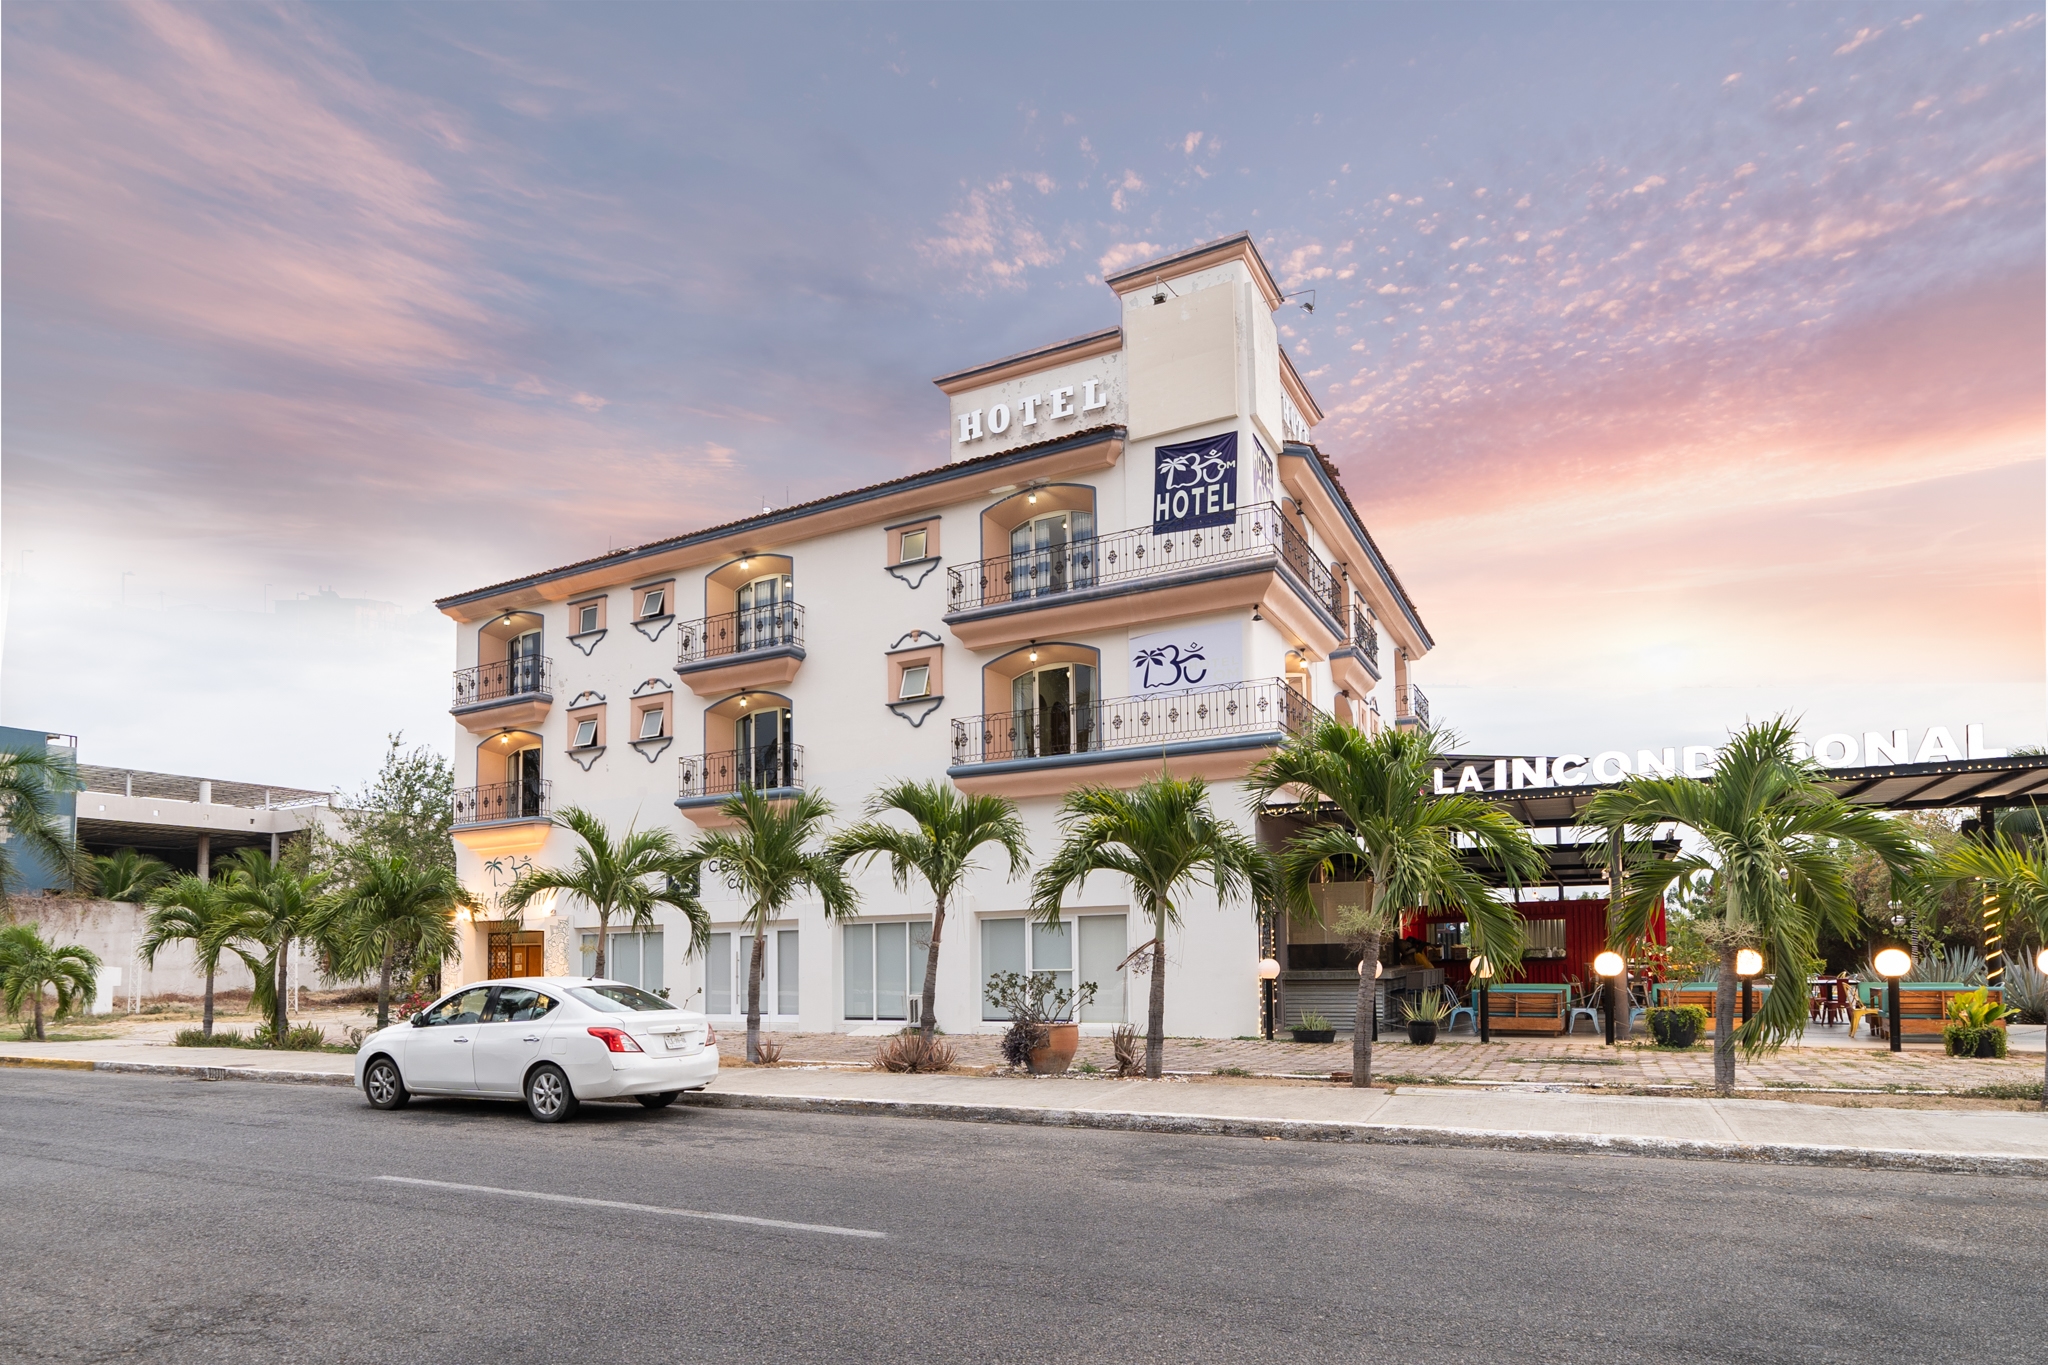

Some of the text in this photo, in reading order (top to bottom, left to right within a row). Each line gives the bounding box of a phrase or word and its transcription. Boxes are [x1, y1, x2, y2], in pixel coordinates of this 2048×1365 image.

[958, 379, 1107, 443] HOTEL
[1156, 482, 1235, 522] HOTEL
[1433, 723, 2007, 795] LA INCONDIONAL
